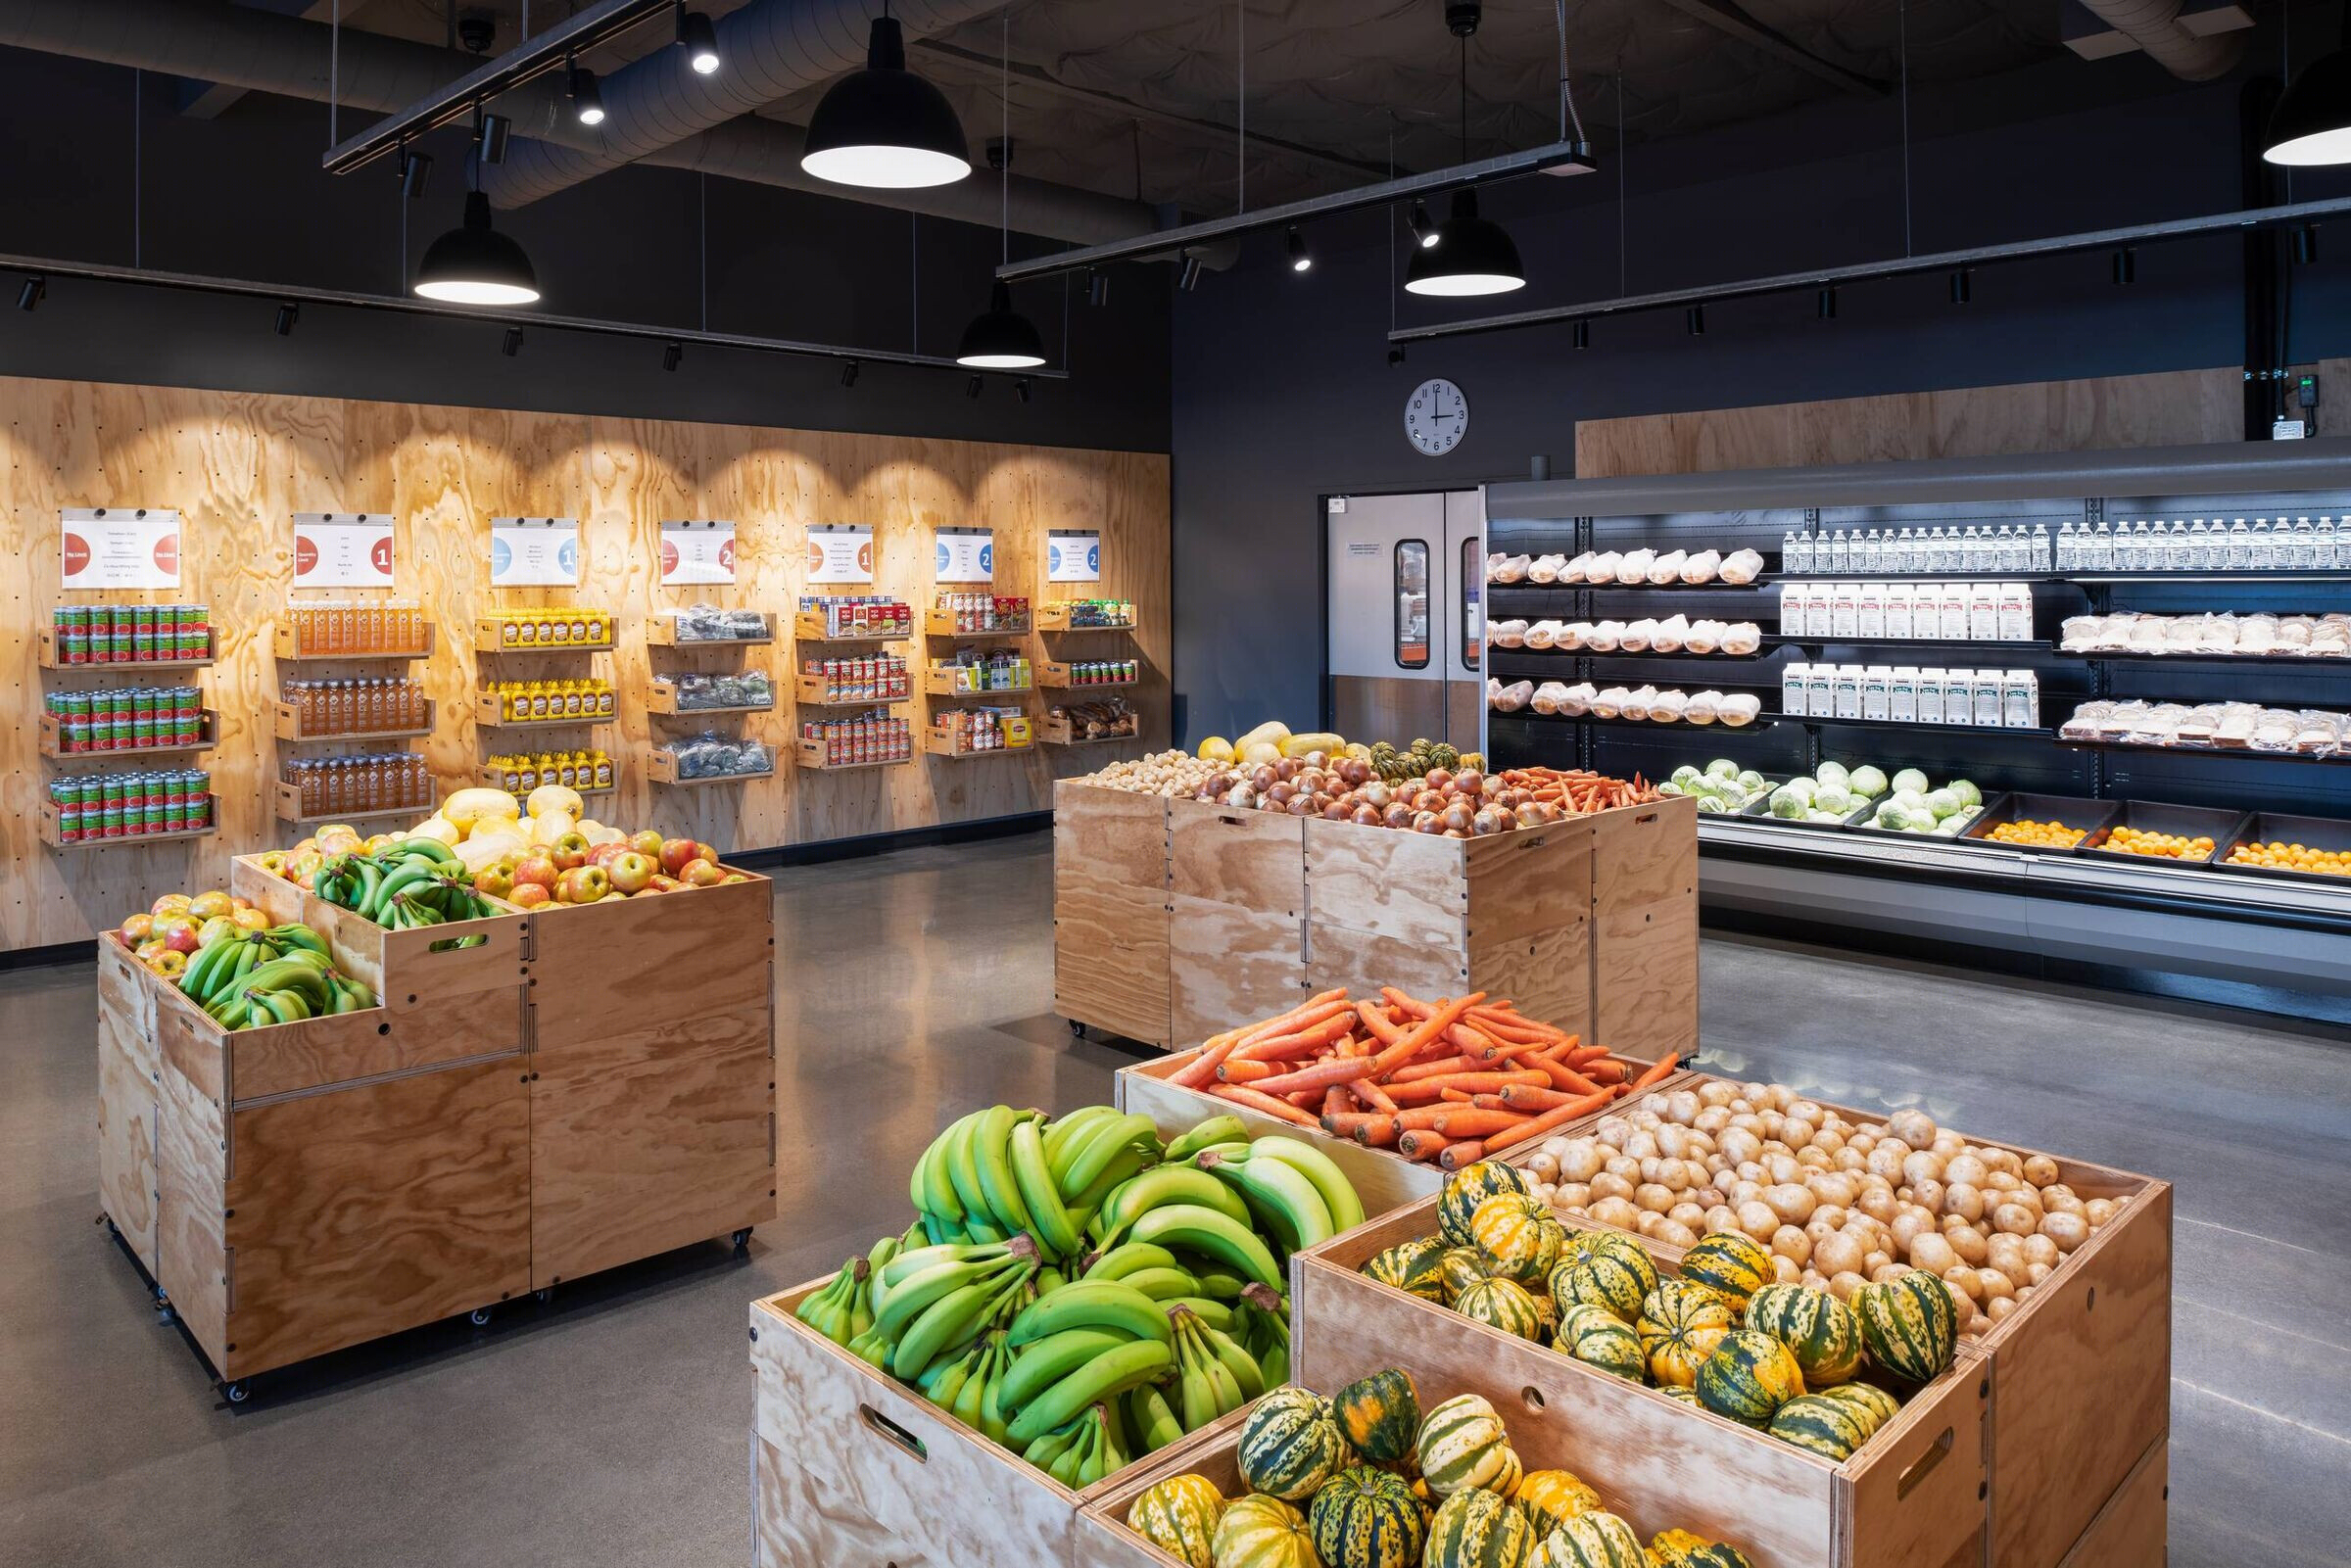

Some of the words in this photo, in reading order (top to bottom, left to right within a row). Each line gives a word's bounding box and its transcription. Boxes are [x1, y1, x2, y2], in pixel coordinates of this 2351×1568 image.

[1432, 384, 1441, 393] 12
[1422, 389, 1427, 399] 11
[1414, 400, 1421, 409] 10
[1455, 396, 1461, 405] 2
[1409, 414, 1415, 424] 9
[1459, 410, 1464, 419] 3
[1413, 429, 1418, 438] 8
[1455, 425, 1460, 434] 4
[1422, 438, 1427, 448] 7
[1434, 442, 1439, 451] 6
[1446, 437, 1452, 446] 5
[377, 548, 389, 566] 1
[563, 549, 573, 565] 1
[723, 549, 733, 565] 2
[862, 551, 870, 566] 1
[983, 553, 989, 566] 2
[1090, 553, 1097, 566] 2
